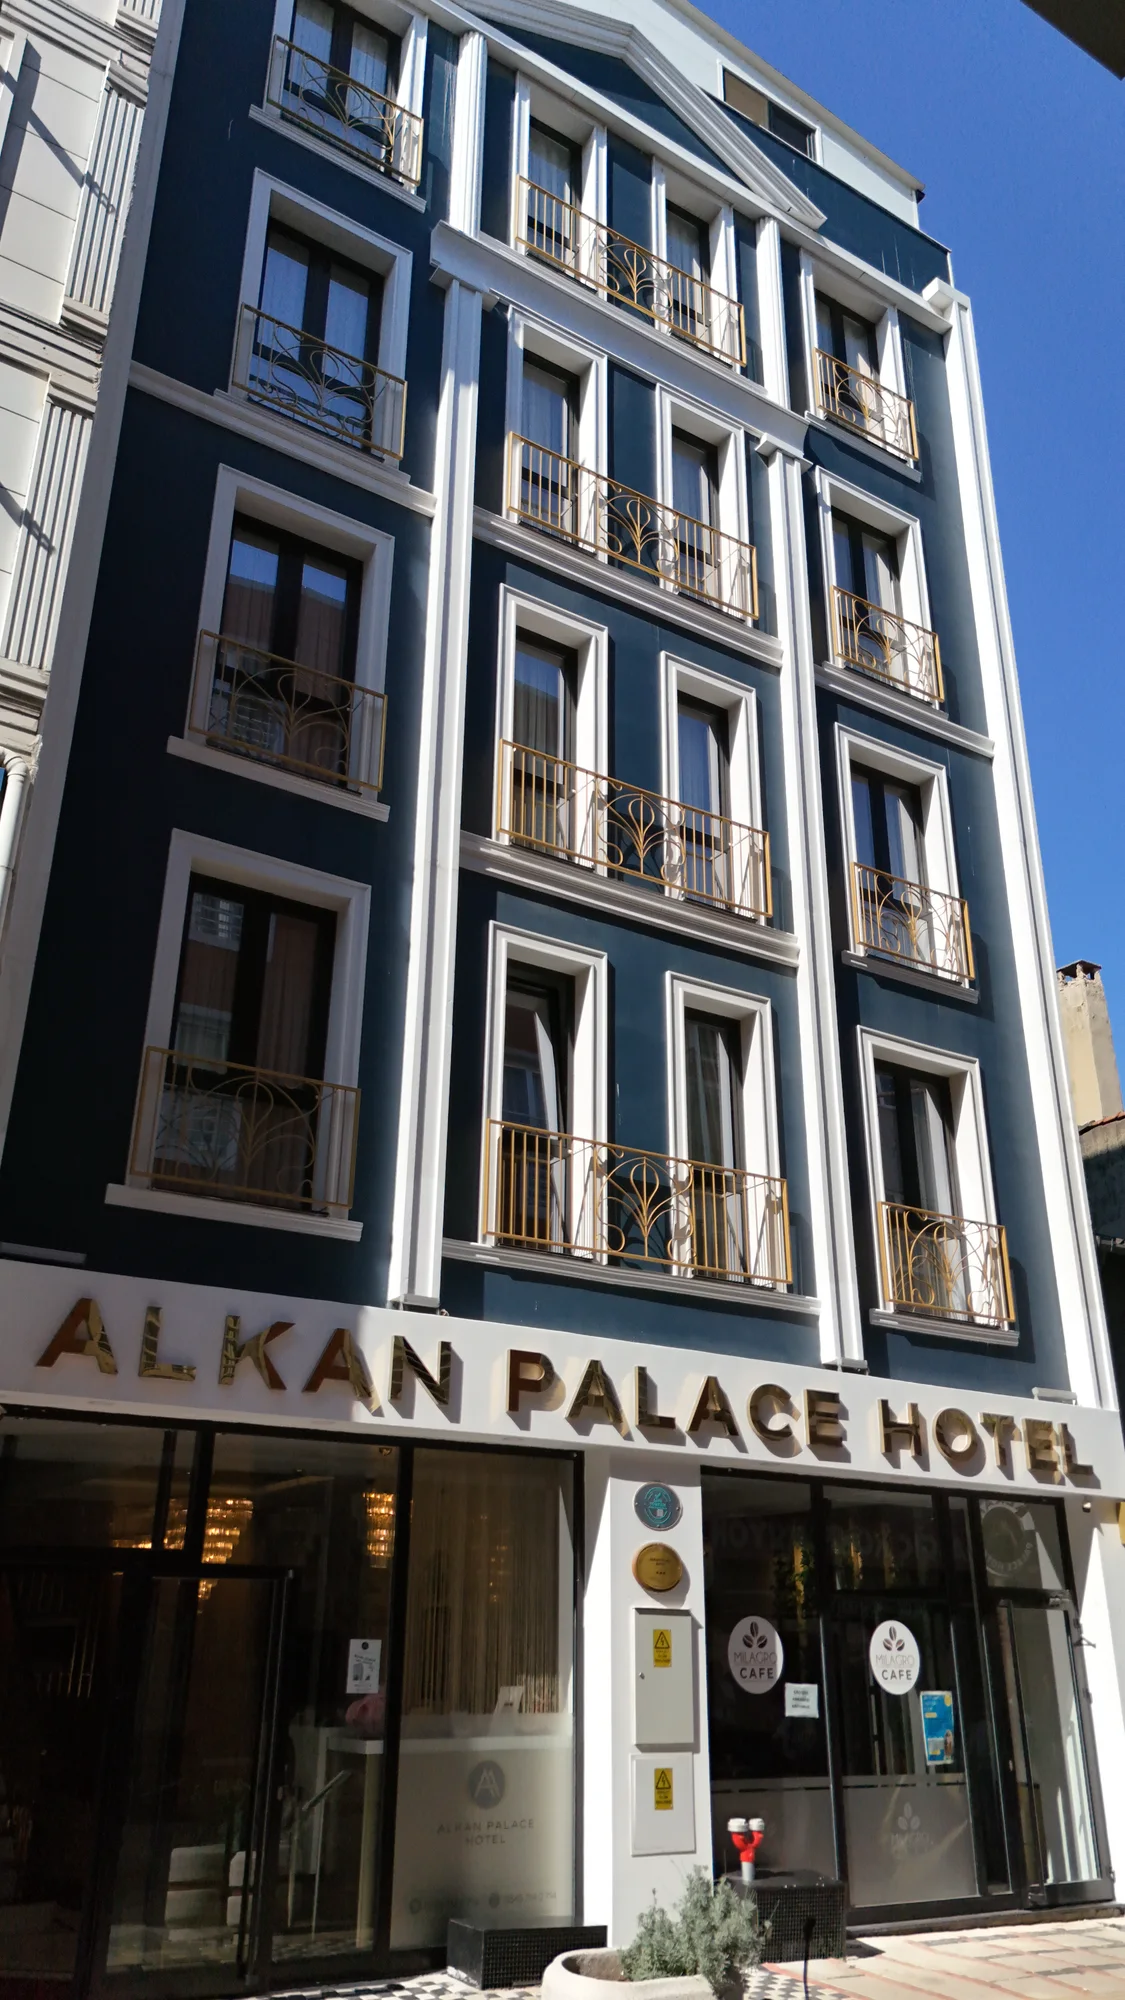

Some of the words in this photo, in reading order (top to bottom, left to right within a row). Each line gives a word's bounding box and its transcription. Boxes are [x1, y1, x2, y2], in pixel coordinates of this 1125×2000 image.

[36, 1297, 452, 1412] ALKAN
[506, 1348, 844, 1447] PALACE
[878, 1397, 1094, 1475] HOTEL
[733, 1651, 778, 1665] MILAGRO
[875, 1654, 916, 1668] MILAGRO
[739, 1667, 775, 1680] CAFE
[881, 1669, 913, 1681] CAFE
[486, 1818, 535, 1832] PALACE
[465, 1834, 506, 1846] HOTEL
